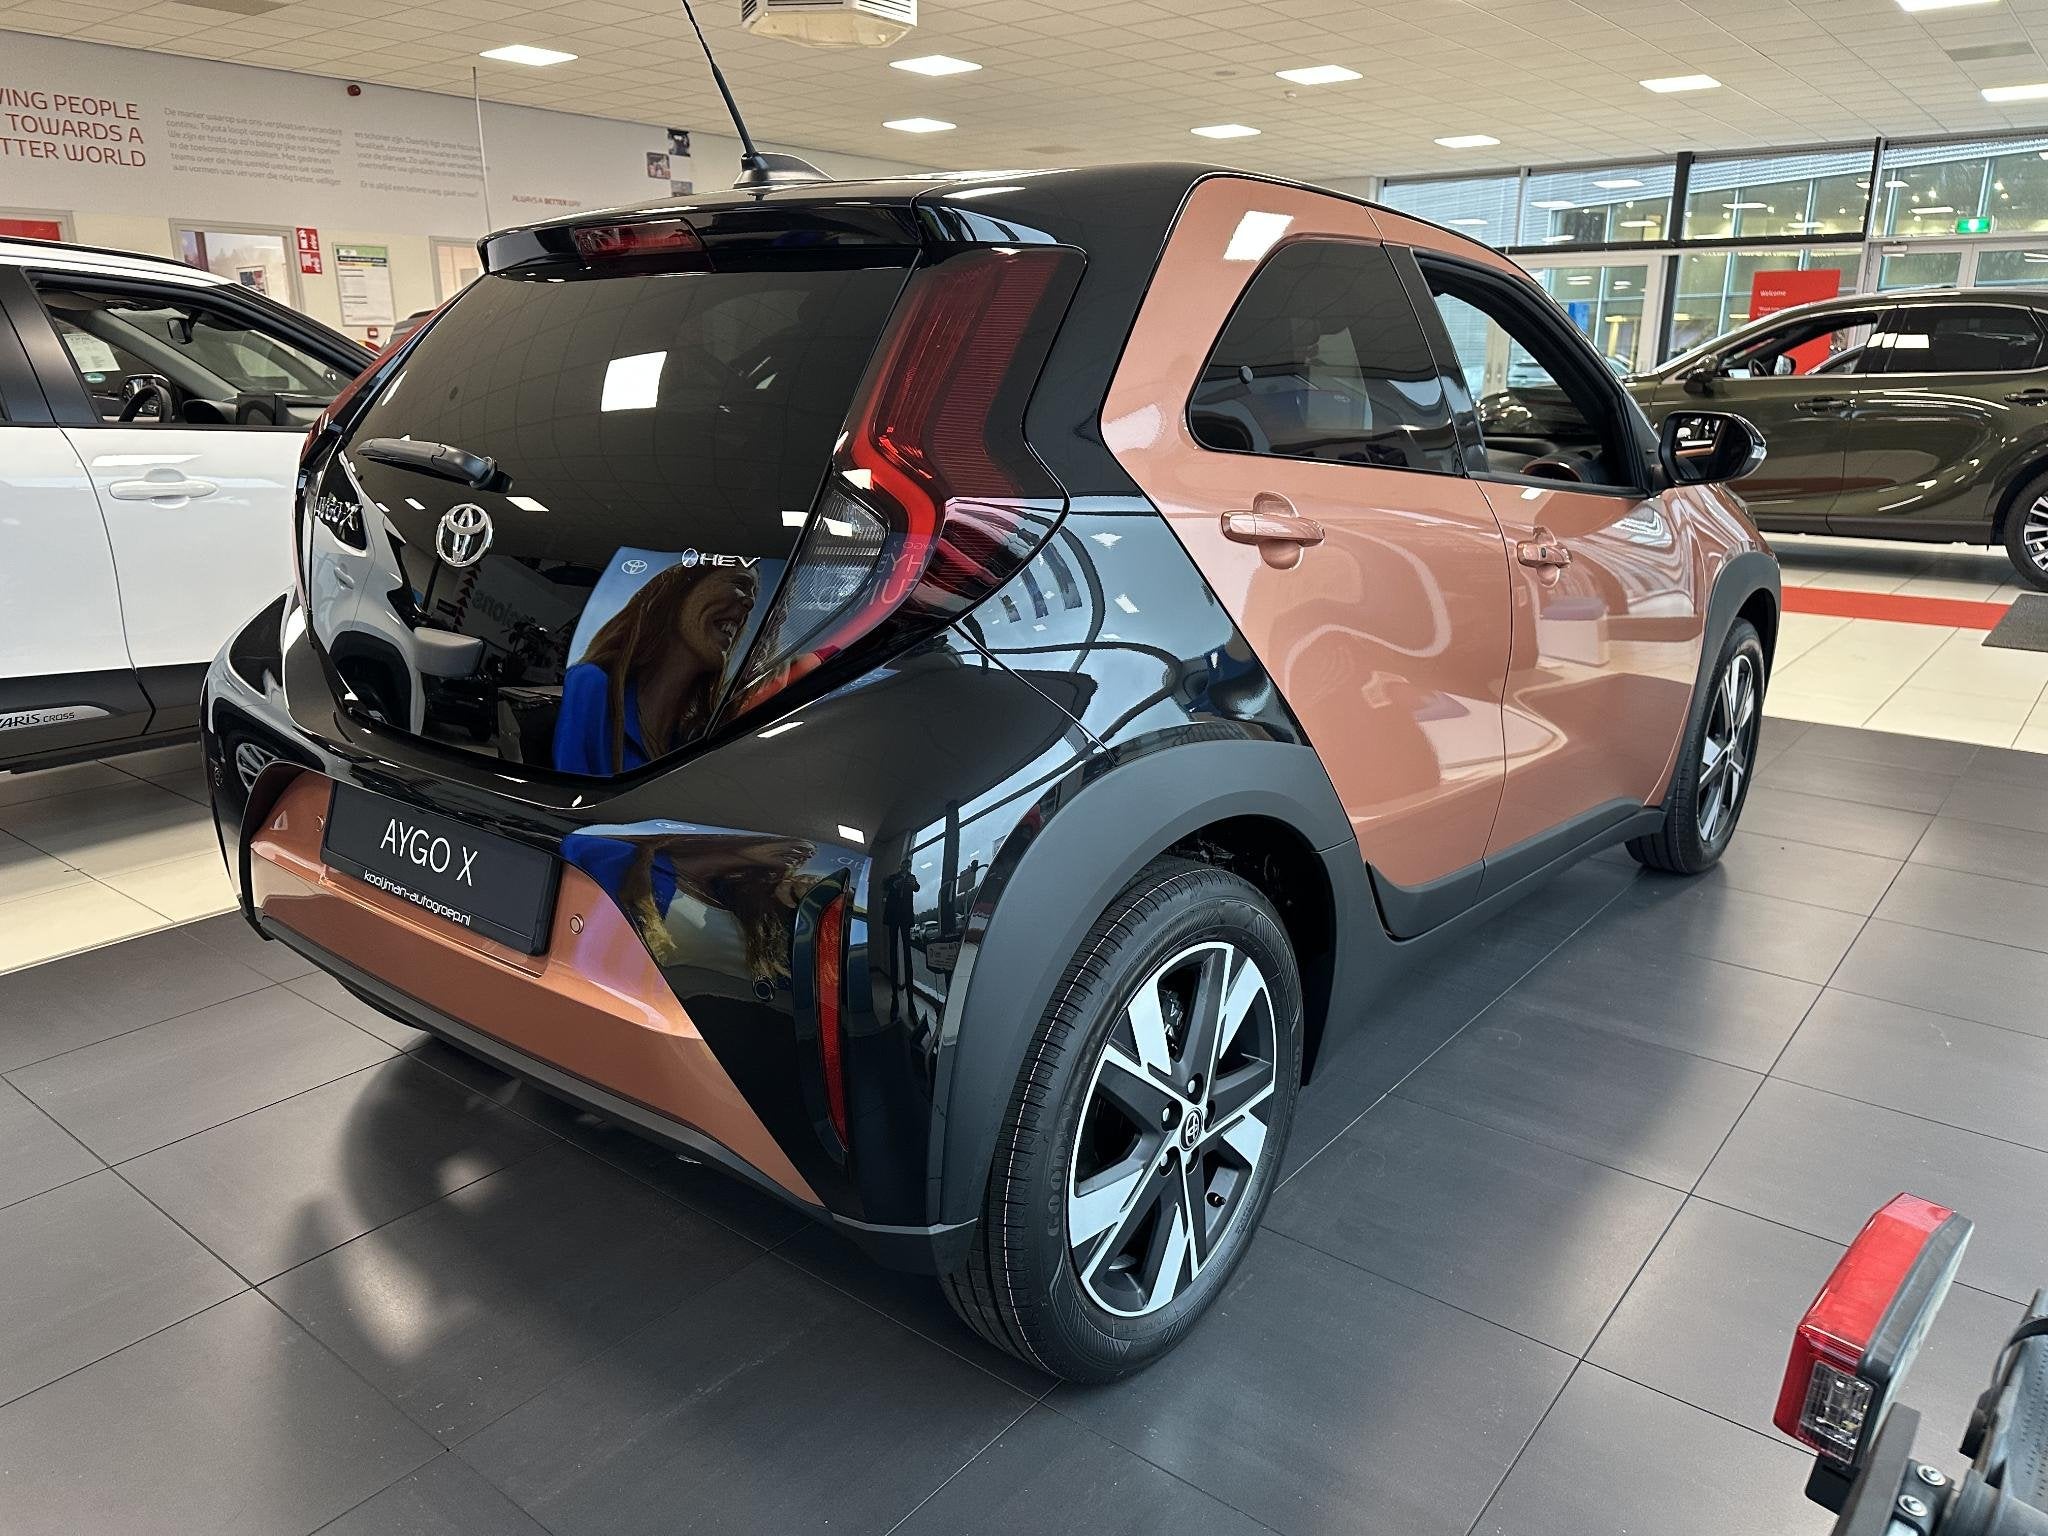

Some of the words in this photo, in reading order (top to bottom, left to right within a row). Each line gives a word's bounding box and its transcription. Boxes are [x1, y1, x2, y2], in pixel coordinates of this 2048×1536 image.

[54, 94, 140, 120] PEOPLE
[5, 113, 122, 142] TOWARDS
[128, 127, 144, 144] A
[200, 122, 226, 134] Toyota
[63, 144, 146, 167] WORLD
[700, 552, 761, 568] HEV
[43, 712, 75, 723] CROSS
[380, 818, 451, 874] AYGO
[456, 846, 478, 887] X
[364, 870, 472, 927] kooijman-autogroep.nl
